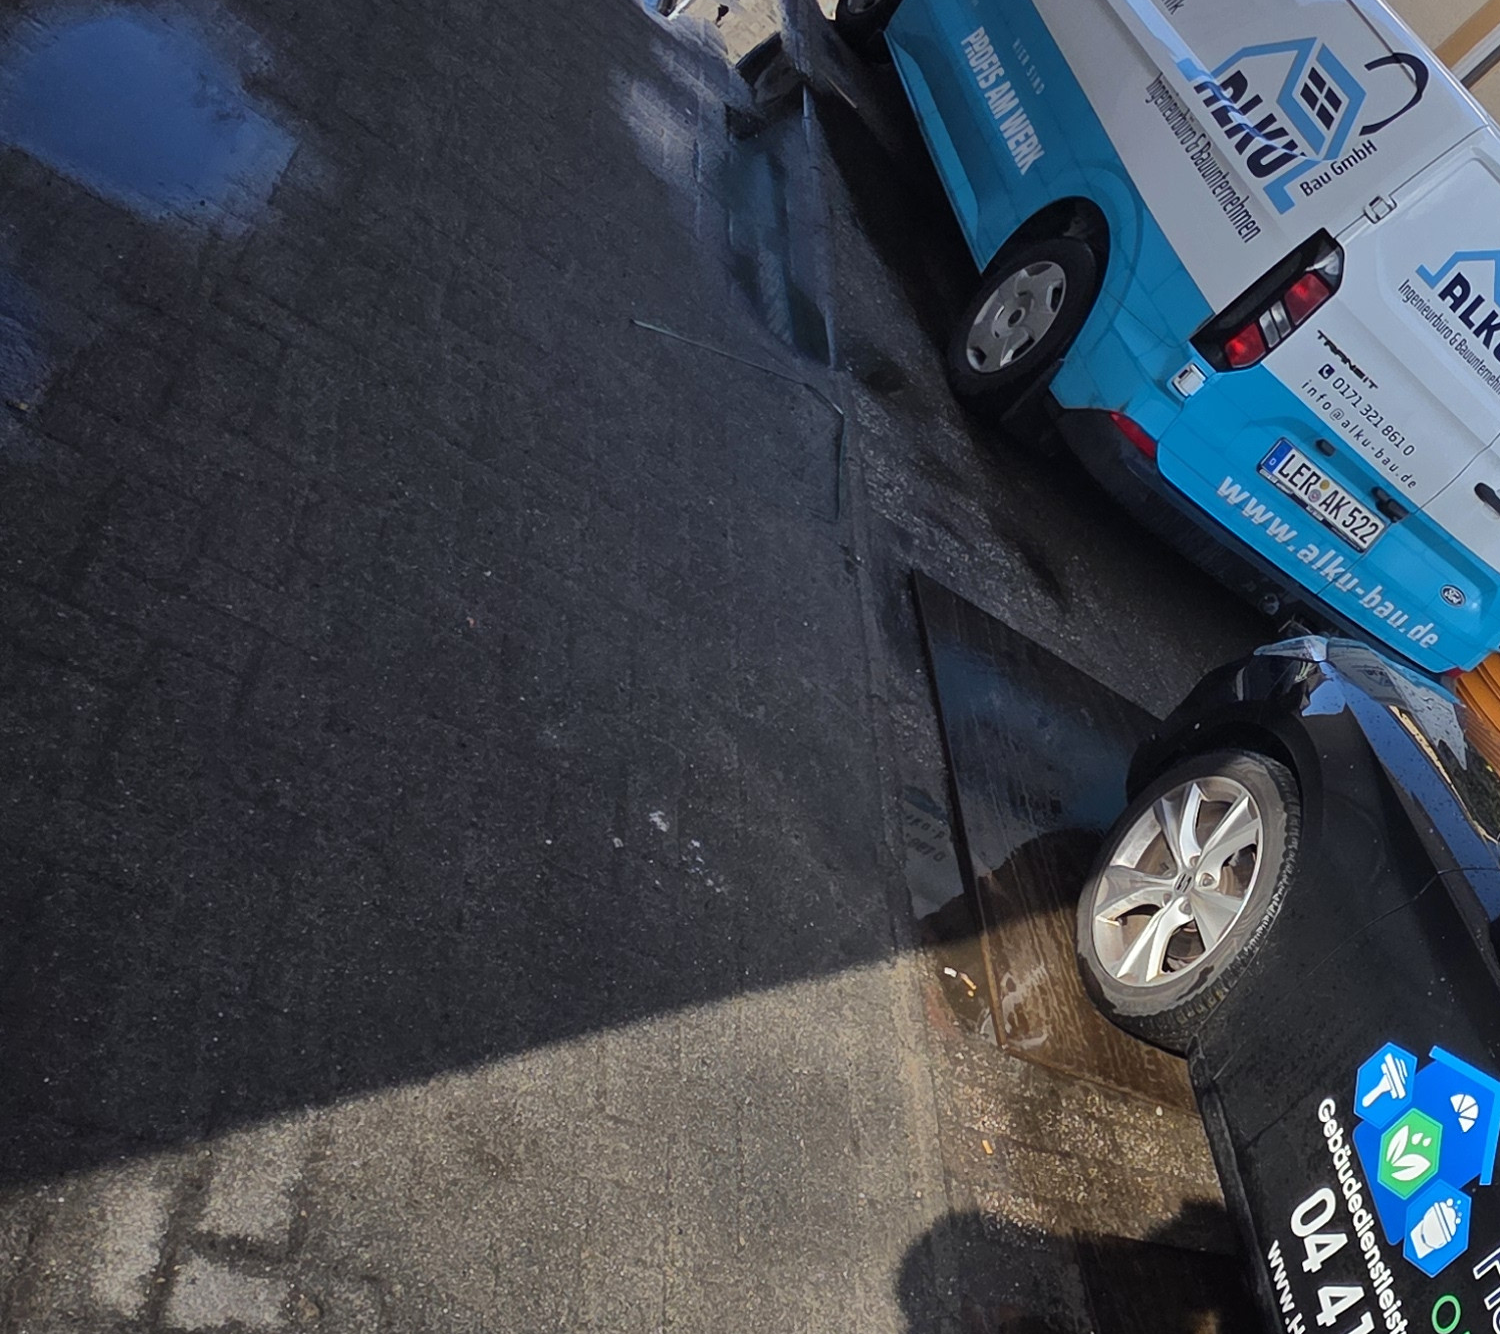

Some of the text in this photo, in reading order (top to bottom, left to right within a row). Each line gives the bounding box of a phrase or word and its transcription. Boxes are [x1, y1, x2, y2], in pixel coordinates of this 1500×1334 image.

[960, 25, 1005, 90] PROFIS
[1026, 66, 1047, 95] SIND
[984, 81, 1020, 120] AM
[1193, 69, 1307, 179] ALKU
[999, 107, 1046, 175] WERK
[1145, 72, 1261, 243] Ingenieurbüro & Bauunternehmen
[1299, 139, 1378, 197] Bau GmbH
[1398, 279, 1453, 339] Ingenieurbüro
[1448, 332, 1461, 346] &
[1317, 329, 1379, 389] TRANSIT
[1301, 379, 1417, 489] info@alku-bau.de
[1332, 377, 1363, 408] 0171
[1360, 404, 1384, 428] 321
[1277, 454, 1322, 496] LER
[1320, 489, 1350, 521] AK
[1341, 513, 1380, 544] 522
[1217, 476, 1439, 648] www.alku-bau.de
[1290, 1187, 1349, 1274] 04
